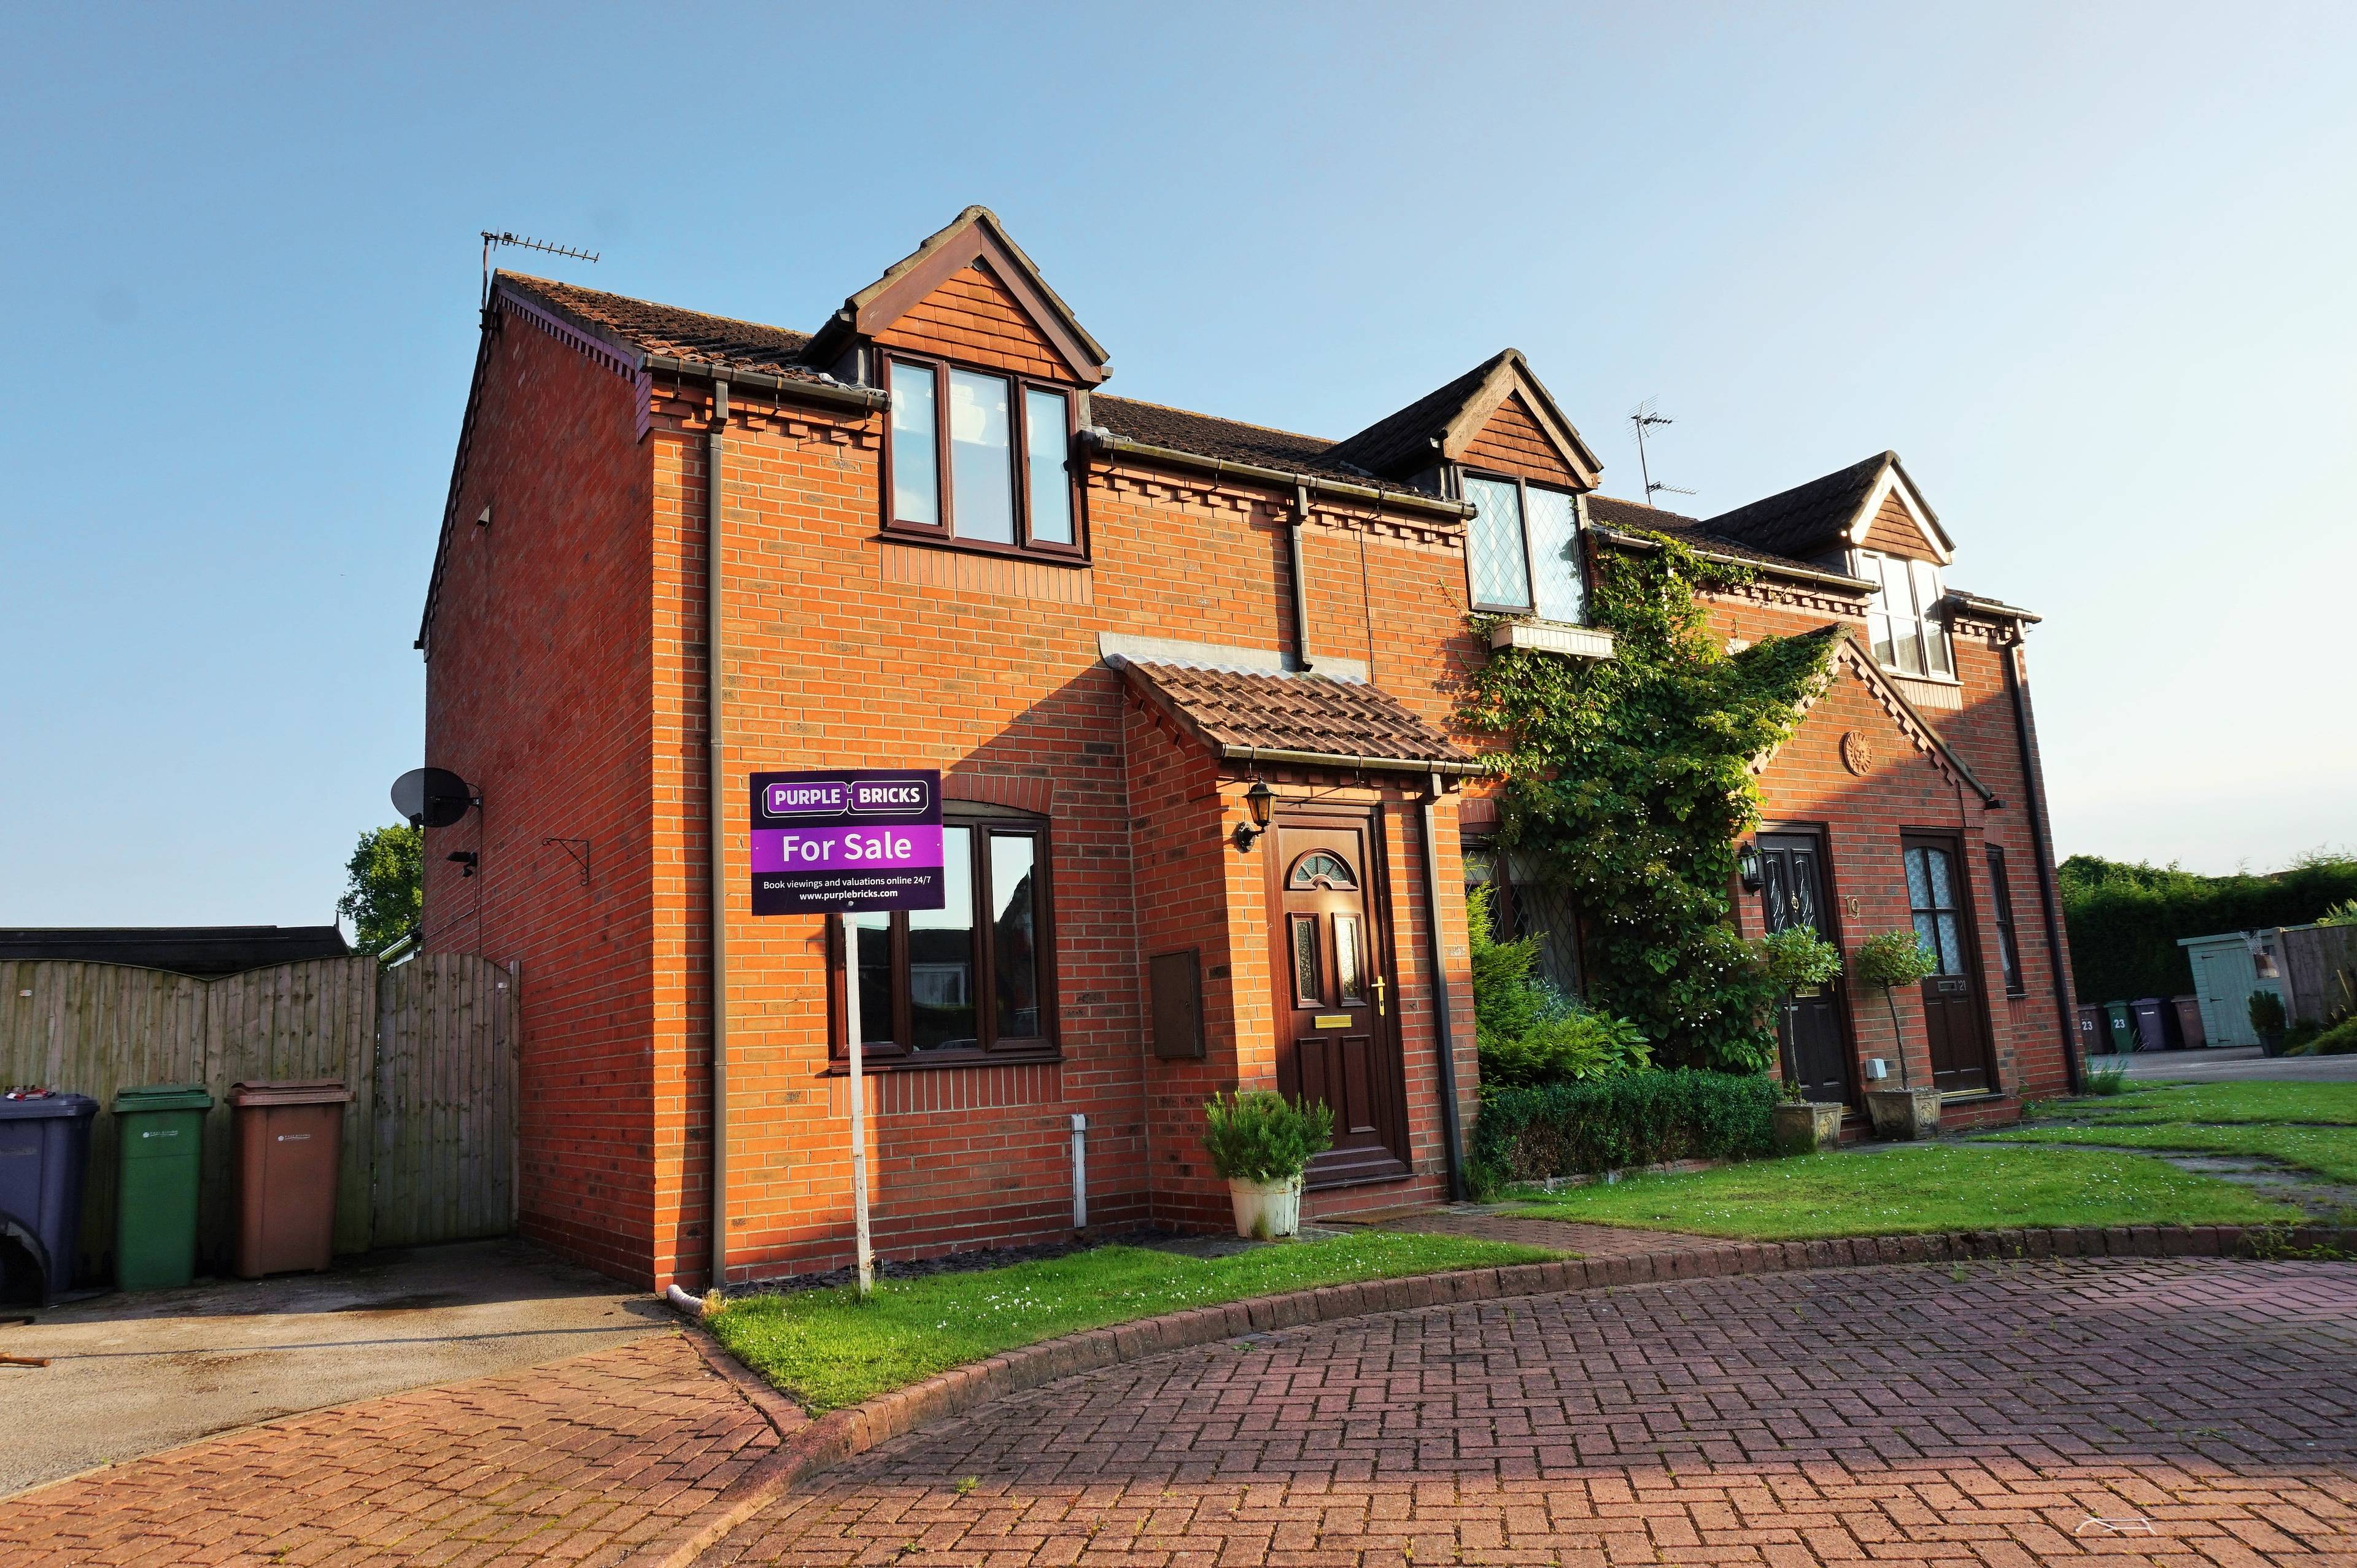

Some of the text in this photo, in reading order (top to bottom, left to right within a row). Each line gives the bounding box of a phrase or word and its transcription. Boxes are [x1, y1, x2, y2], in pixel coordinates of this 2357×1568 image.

[775, 787, 920, 805] PURPLE BRICKS
[783, 831, 912, 862] For Sale
[764, 880, 785, 889] Book
[786, 879, 823, 889] viewings
[824, 878, 840, 887] and
[913, 876, 931, 885] 24/7
[799, 889, 898, 901] www.purplebricks.com
[1844, 895, 1860, 920] 19
[1958, 979, 1967, 991] 21
[2081, 1021, 2093, 1030] 23
[2114, 1019, 2126, 1029] 23
